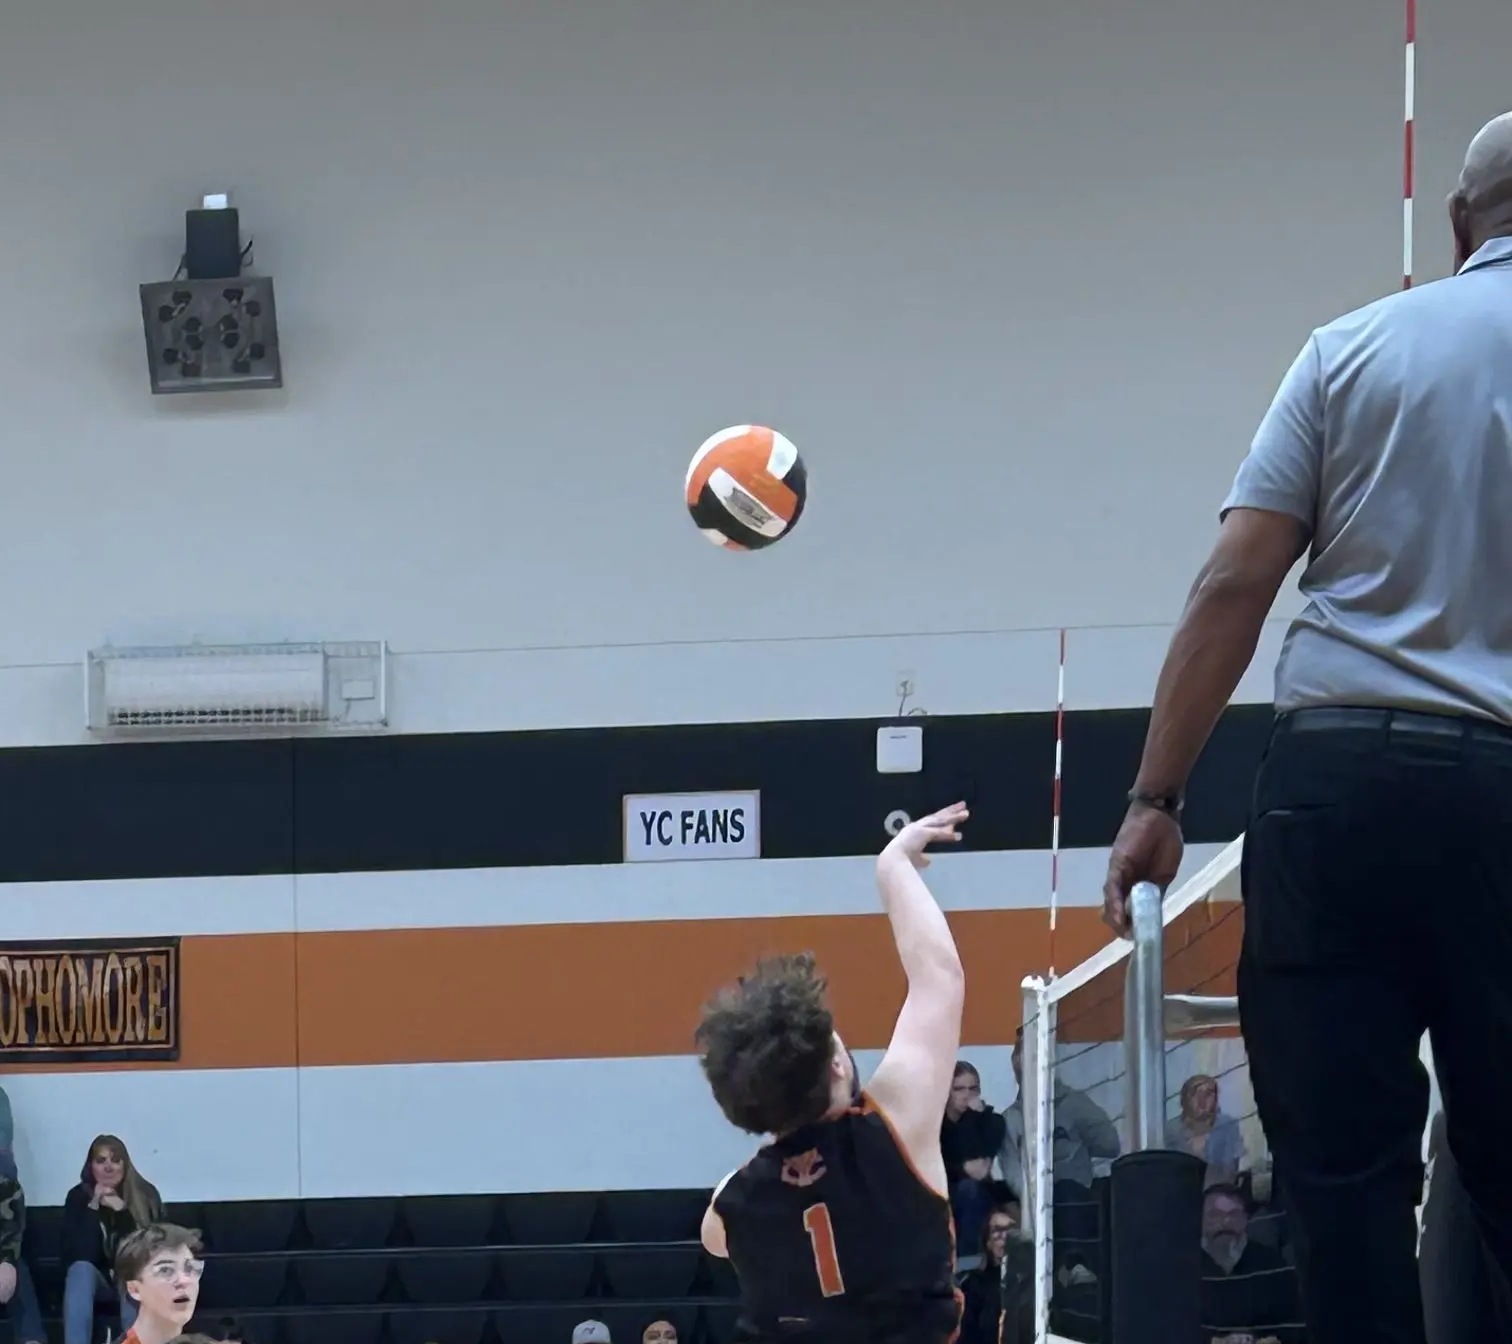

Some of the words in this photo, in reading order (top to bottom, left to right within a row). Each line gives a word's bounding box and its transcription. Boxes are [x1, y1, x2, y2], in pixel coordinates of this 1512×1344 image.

[640, 809, 673, 846] YC
[680, 808, 745, 845] FANS
[803, 1202, 845, 1298] 1
